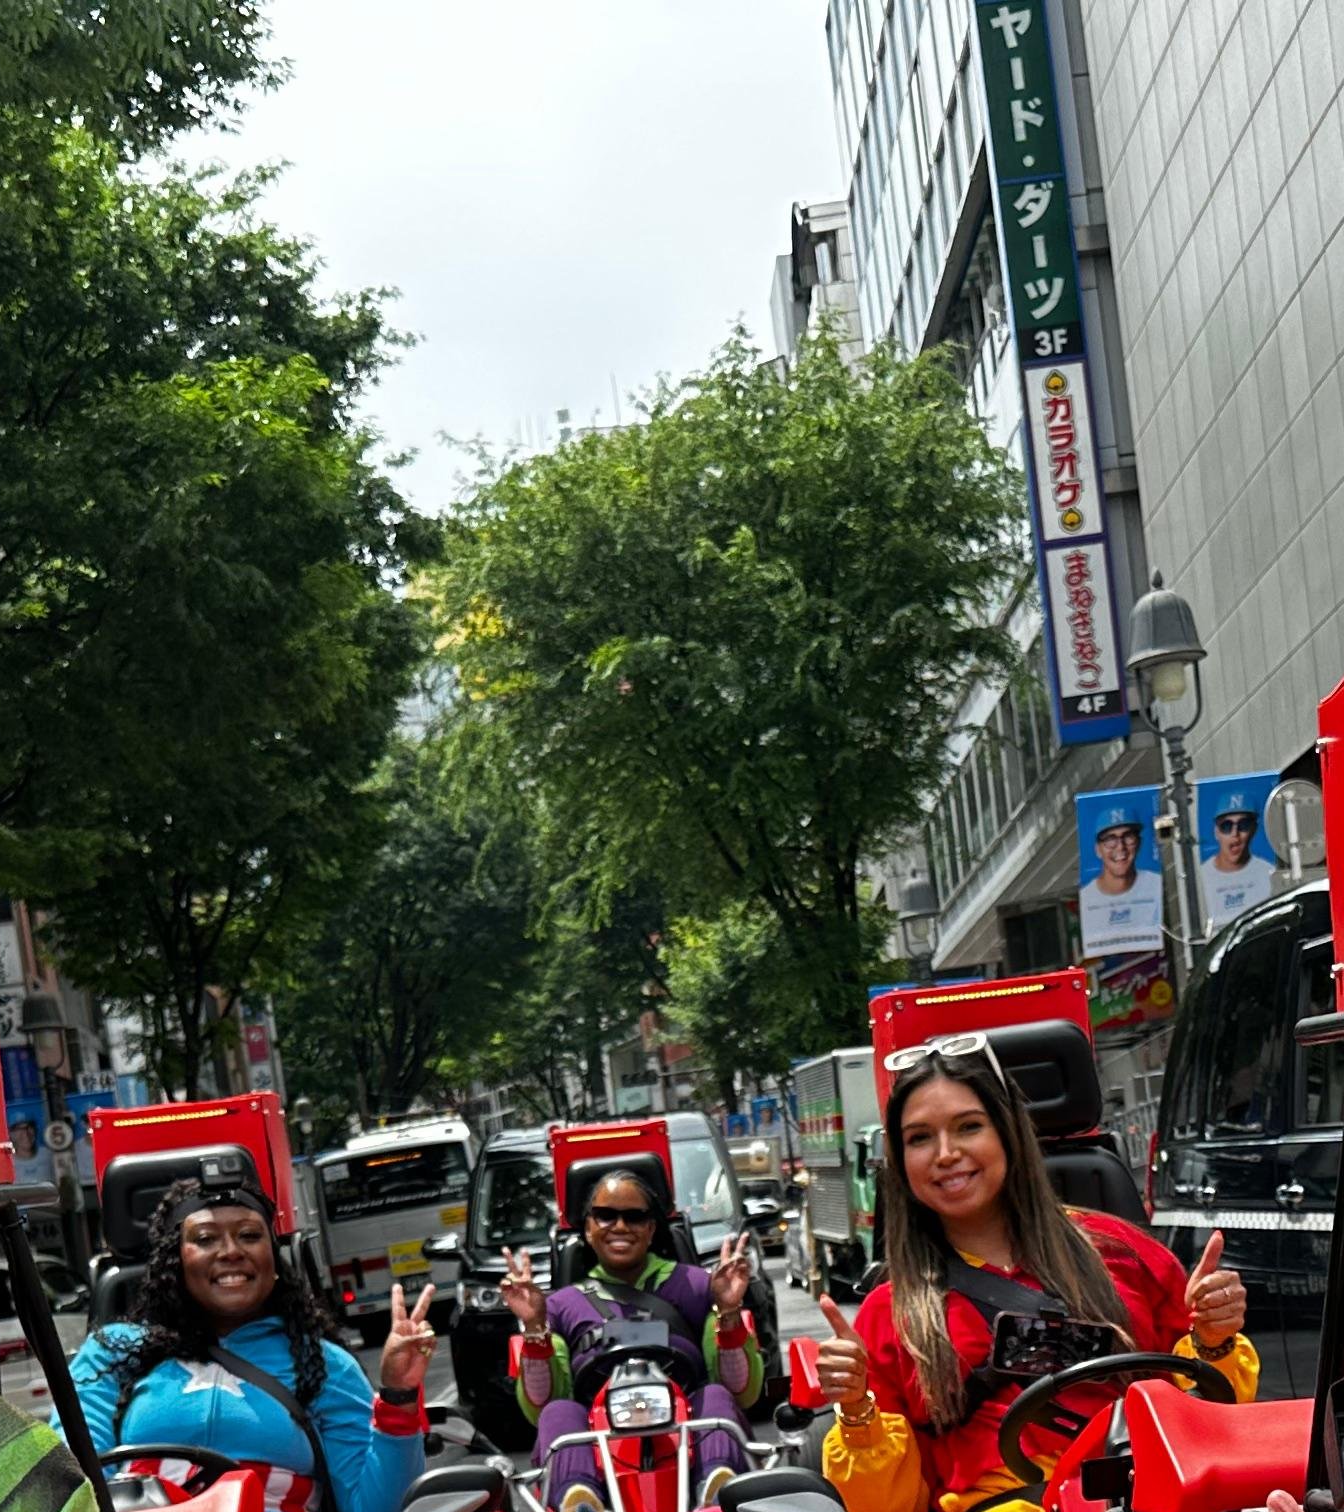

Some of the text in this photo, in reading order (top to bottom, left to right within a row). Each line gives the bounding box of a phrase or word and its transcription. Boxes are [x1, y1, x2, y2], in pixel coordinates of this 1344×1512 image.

[1034, 327, 1068, 356] 3F
[1044, 397, 1082, 509] カラオケ
[1063, 550, 1102, 692] まねきねこ
[1076, 694, 1107, 714] 4F
